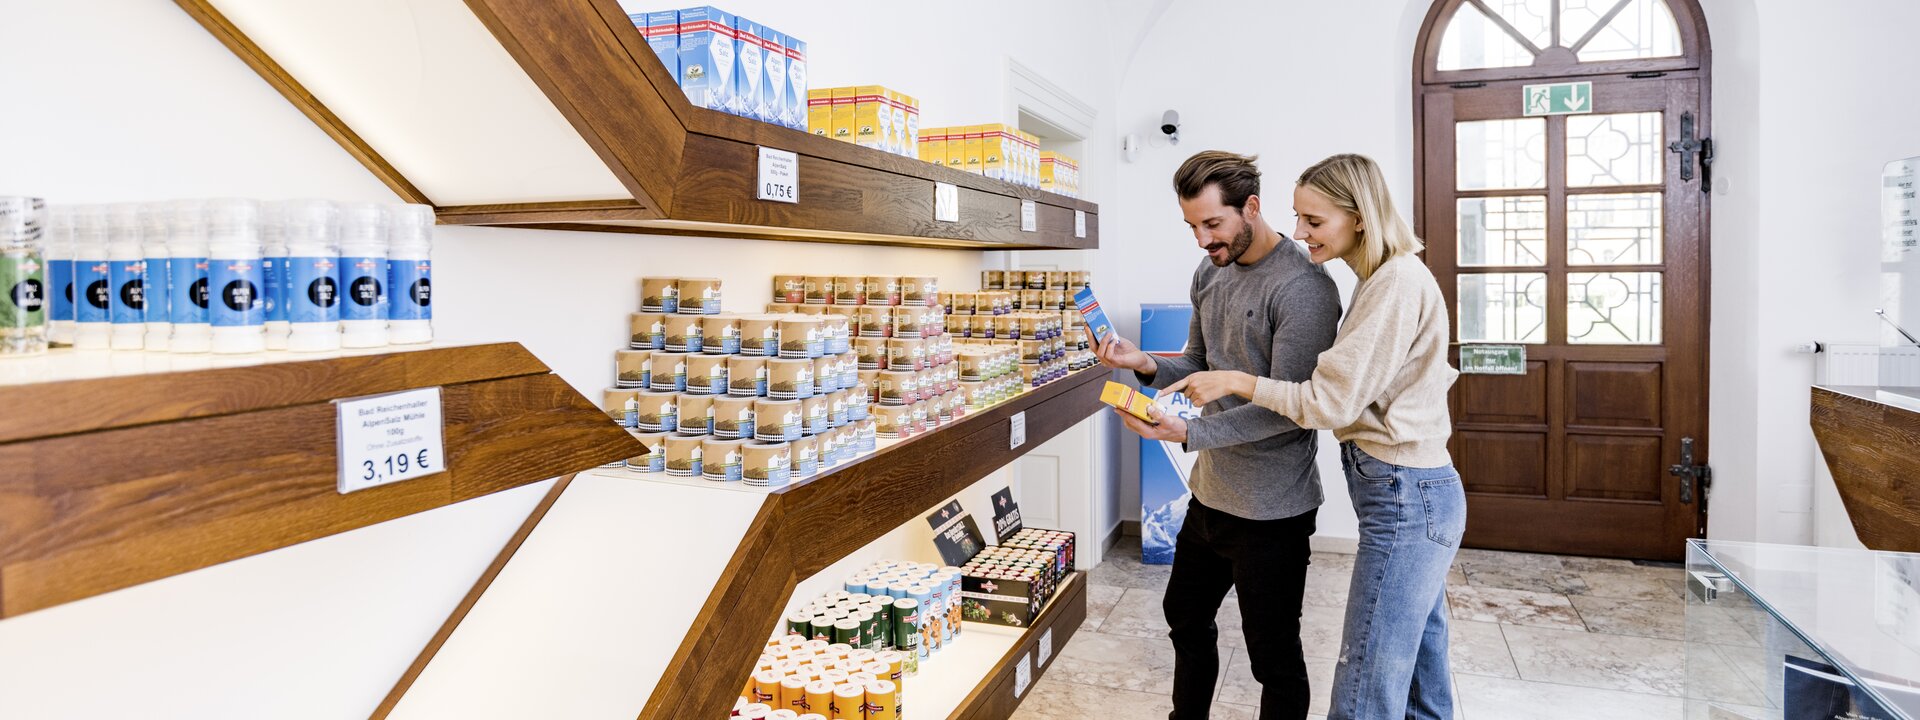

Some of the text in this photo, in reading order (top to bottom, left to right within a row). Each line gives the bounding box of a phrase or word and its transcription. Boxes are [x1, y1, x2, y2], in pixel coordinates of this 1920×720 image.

[766, 182, 792, 199] 0,75 €
[232, 288, 250, 296] ALPEN
[359, 284, 375, 292] ALPEN
[234, 295, 248, 303] SALZ
[360, 291, 374, 299] SALZ
[1473, 348, 1509, 356] Notausgang
[358, 400, 428, 417] Bad Reichenhaller
[362, 412, 425, 428] AlpenSalz Mühle
[386, 428, 405, 437] 100g
[363, 448, 429, 482] 3,19 €
